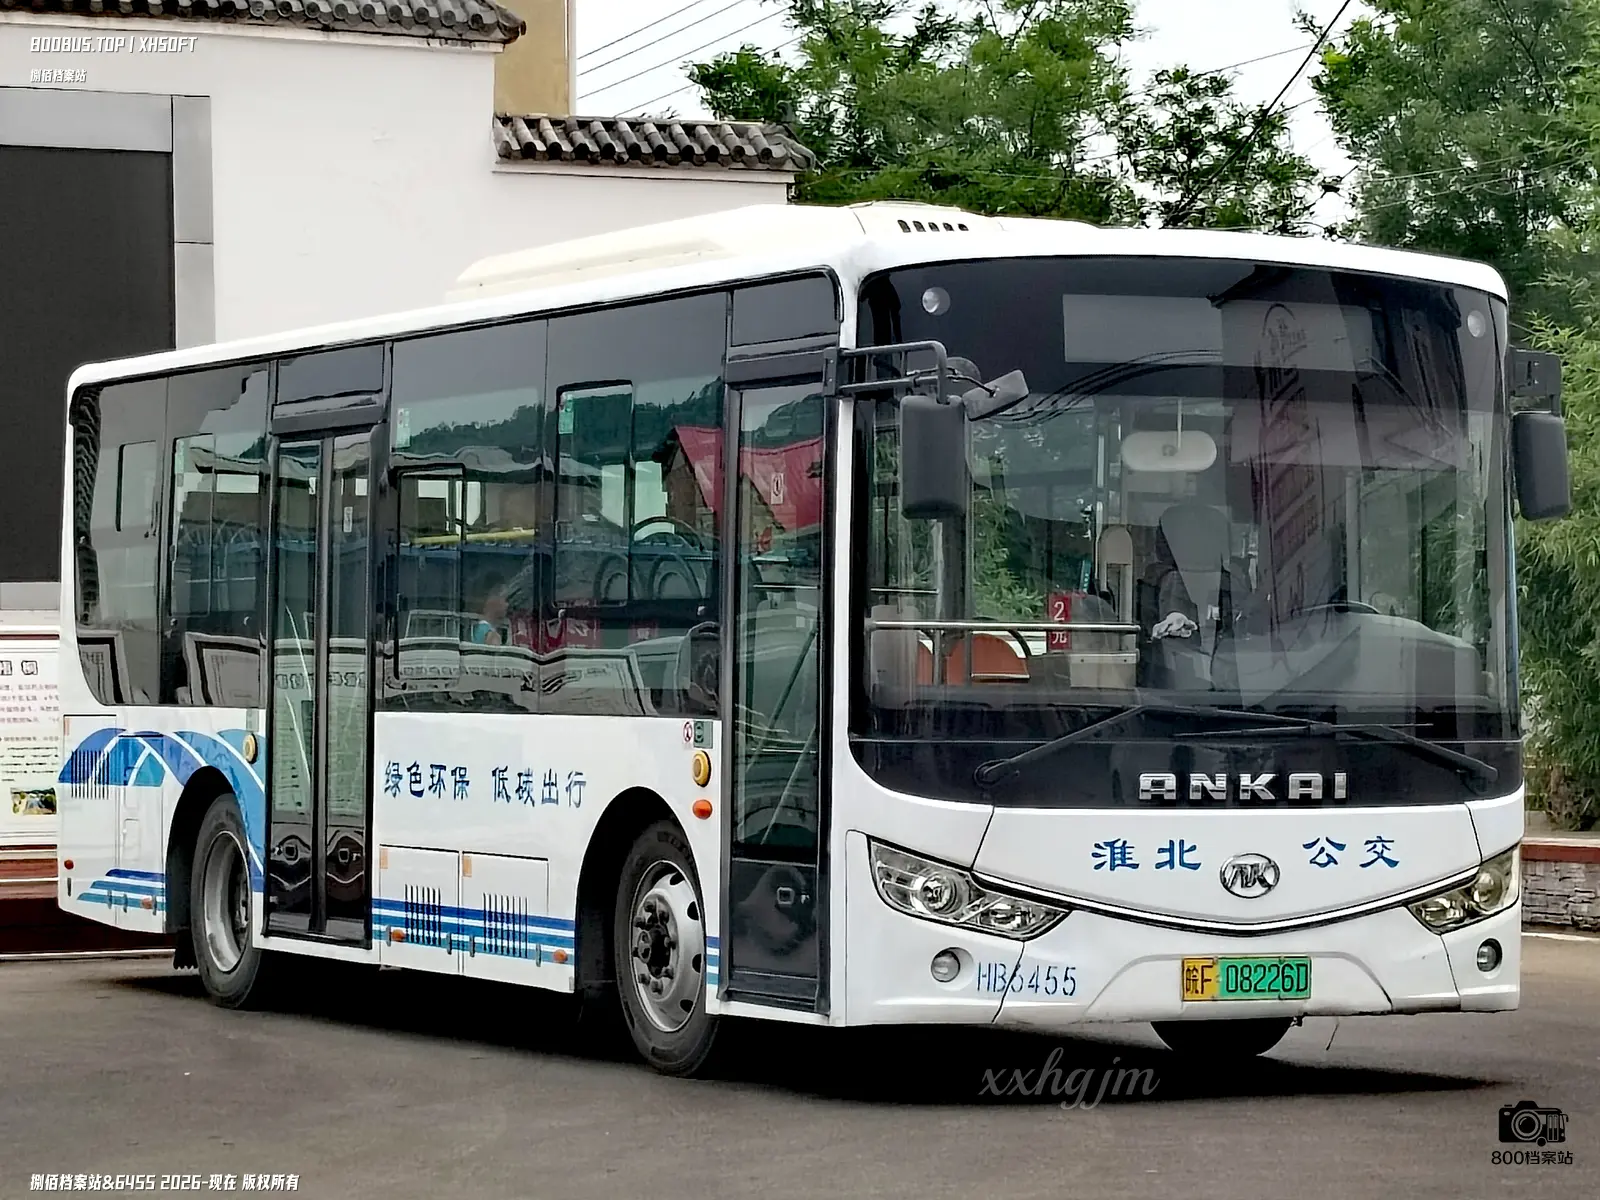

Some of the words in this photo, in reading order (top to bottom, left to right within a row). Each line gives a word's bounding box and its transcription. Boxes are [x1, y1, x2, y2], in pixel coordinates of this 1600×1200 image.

[384, 760, 470, 800] 绿色环保
[491, 765, 587, 808] 低碳出行
[1138, 772, 1348, 800] ANKAI
[1091, 838, 1203, 872] 淮北
[1302, 835, 1400, 868] 公交
[977, 962, 1077, 996] HB6455
